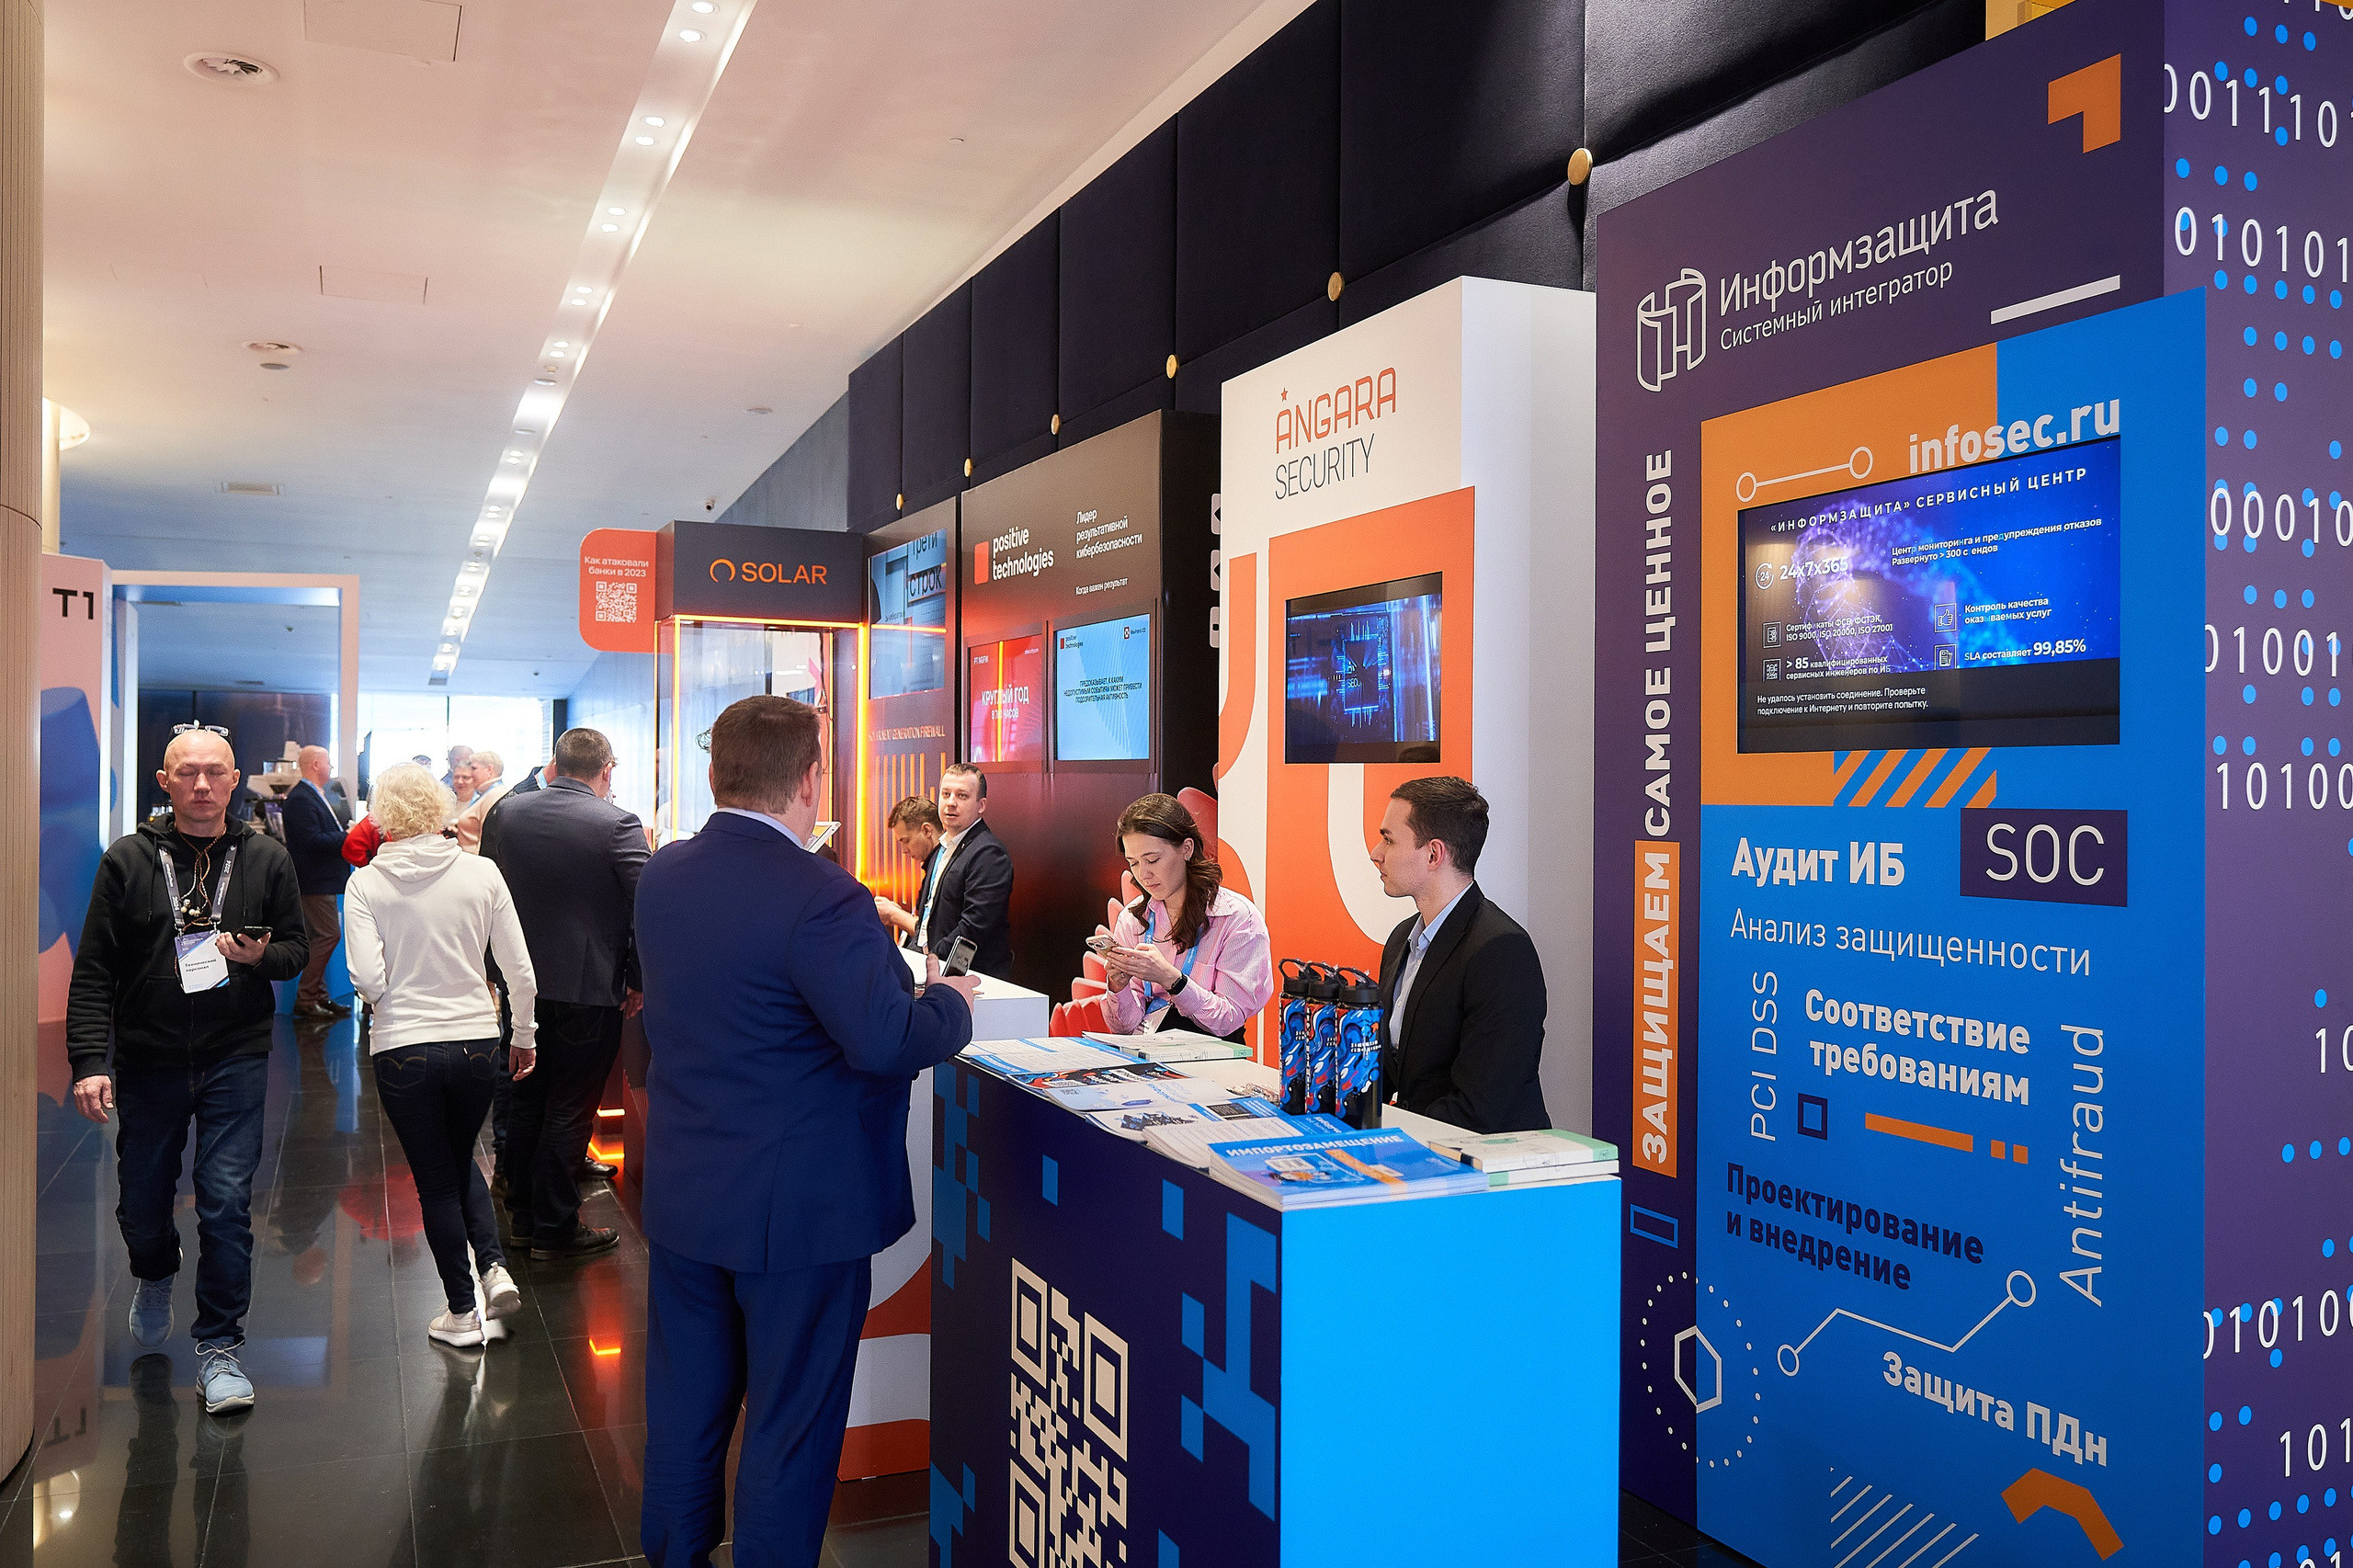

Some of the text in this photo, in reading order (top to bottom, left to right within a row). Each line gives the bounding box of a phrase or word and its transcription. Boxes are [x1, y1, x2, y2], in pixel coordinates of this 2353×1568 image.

[2164, 63, 2353, 148] 001110
[1721, 188, 1999, 316] Информзащита
[2175, 207, 2348, 283] 010101
[1721, 260, 1953, 351] Системный интегратор
[1276, 367, 1396, 454] ANGARA
[1909, 398, 2120, 473] infosec.ru
[1276, 433, 1375, 500] SECURITY
[1075, 509, 1097, 524] Лидер
[1770, 468, 2087, 532] «ИНФОРМЗАЩИТА» СЕРВИСНЫЙ ЦЕНТР
[2211, 487, 2353, 546] 00010
[993, 526, 1029, 558] positive
[1075, 516, 1129, 544] результативной
[1075, 533, 1142, 559] кибербезопасности
[1892, 517, 2102, 556] Центр мониторинга и предупреждения отказов
[585, 556, 649, 568] Как атаковали
[588, 567, 616, 575] банки
[624, 568, 647, 577] 2023
[741, 562, 827, 585] SOLAR
[993, 548, 1054, 581] technologies
[1892, 552, 1938, 566] Развернуто
[1945, 549, 1961, 559] 300
[1963, 544, 1998, 555] сендов
[52, 587, 94, 619] T1
[1075, 577, 1129, 596] Когда важен результат
[1964, 597, 2049, 614] Контроль качества
[1786, 633, 1798, 642] ISO
[1859, 626, 1871, 634] ISO
[2026, 608, 2052, 620] услуг
[1795, 656, 1809, 669] 85
[1810, 655, 1888, 669] квалифицированных
[1964, 638, 2086, 661] SLA составляет 99,85%
[1786, 671, 1824, 680] сервисных
[1868, 665, 1879, 674] по
[982, 684, 1029, 706] КРУГЛЫЙ ГОД
[1757, 687, 1927, 706] Не удалось установить соединение. Проверьте
[1757, 706, 1803, 717] подключение
[1809, 704, 1847, 714] Интернету
[1855, 702, 1893, 713] повторите
[1893, 699, 1928, 710] попытку.
[1643, 449, 1677, 1164] ЗАЩИЩАЕМ САМОЕ ЦЕННОЕ
[2216, 762, 2353, 810] 10100
[1731, 836, 1905, 888] Аудит ИБ
[1985, 823, 2105, 886] SOC
[1730, 907, 2090, 976] Анализ защищенности
[1804, 988, 2031, 1054] Соответствие
[1750, 971, 1779, 1142] PCI DSS
[1809, 1040, 2029, 1106] требованиям
[1224, 1134, 1404, 1158] ИМПОРТОЗАМЕЩЕНИЕ
[2059, 1023, 2104, 1307] Antifraud
[1726, 1162, 1984, 1265] Проектирование
[1726, 1210, 1912, 1290] и внедрение
[2203, 1290, 2353, 1359] 01010
[1882, 1351, 2107, 1467] Защита ПДн
